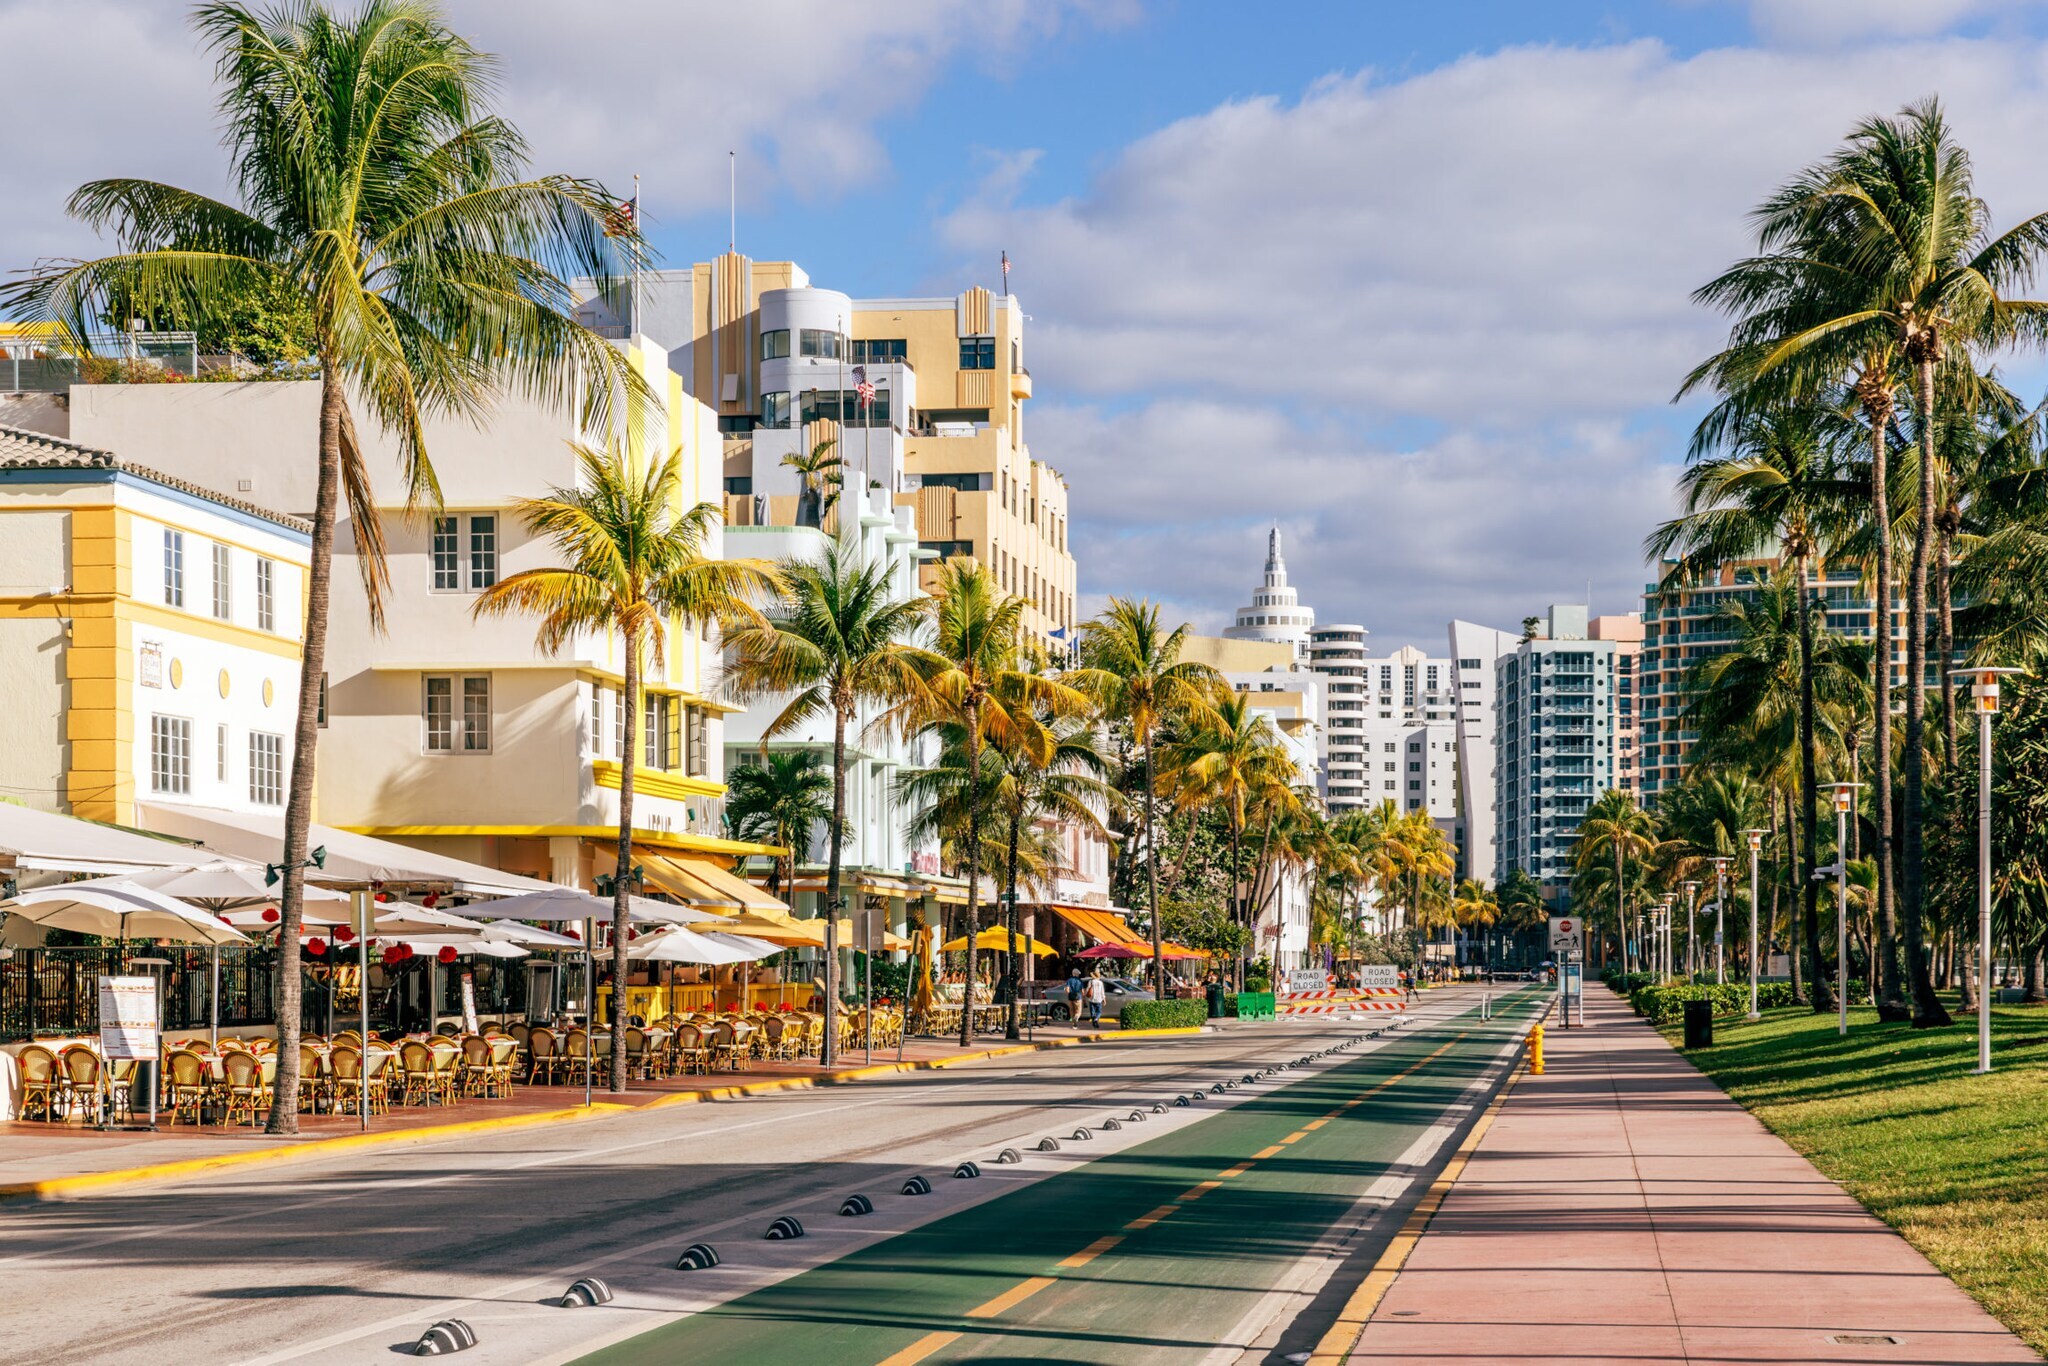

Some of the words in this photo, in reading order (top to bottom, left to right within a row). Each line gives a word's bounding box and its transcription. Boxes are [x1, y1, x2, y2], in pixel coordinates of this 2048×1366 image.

[1297, 972, 1320, 980] ROAD
[1368, 968, 1391, 976] ROAD
[1364, 977, 1395, 985] CLOSED
[1293, 981, 1324, 990] CLOSED
